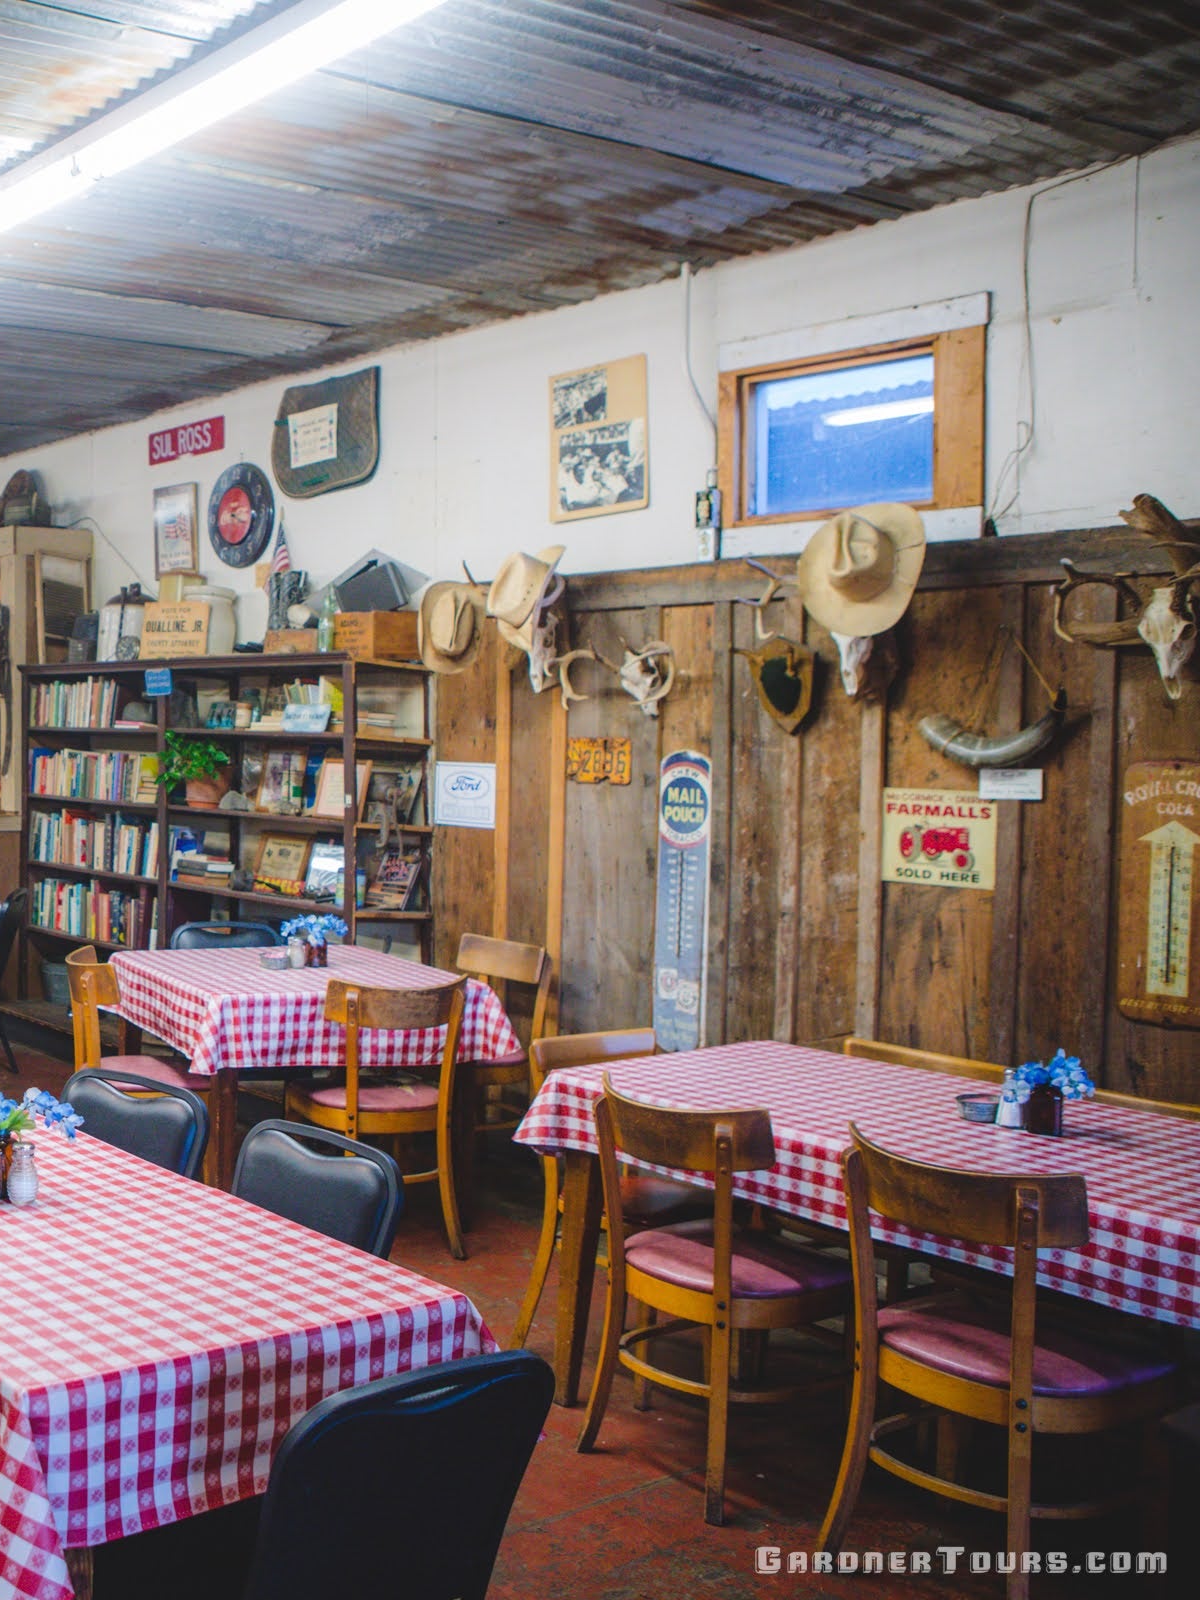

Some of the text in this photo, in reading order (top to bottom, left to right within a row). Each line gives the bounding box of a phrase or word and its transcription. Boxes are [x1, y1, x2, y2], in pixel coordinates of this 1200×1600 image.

[152, 422, 212, 460] SUL ROSS
[671, 769, 699, 778] CHEW
[451, 775, 482, 791] Ford
[667, 787, 704, 804] MAIL
[664, 805, 704, 823] POUCH
[886, 803, 992, 819] FARMALLS
[1156, 802, 1194, 816] COLA
[896, 868, 981, 884] SOLD HERE
